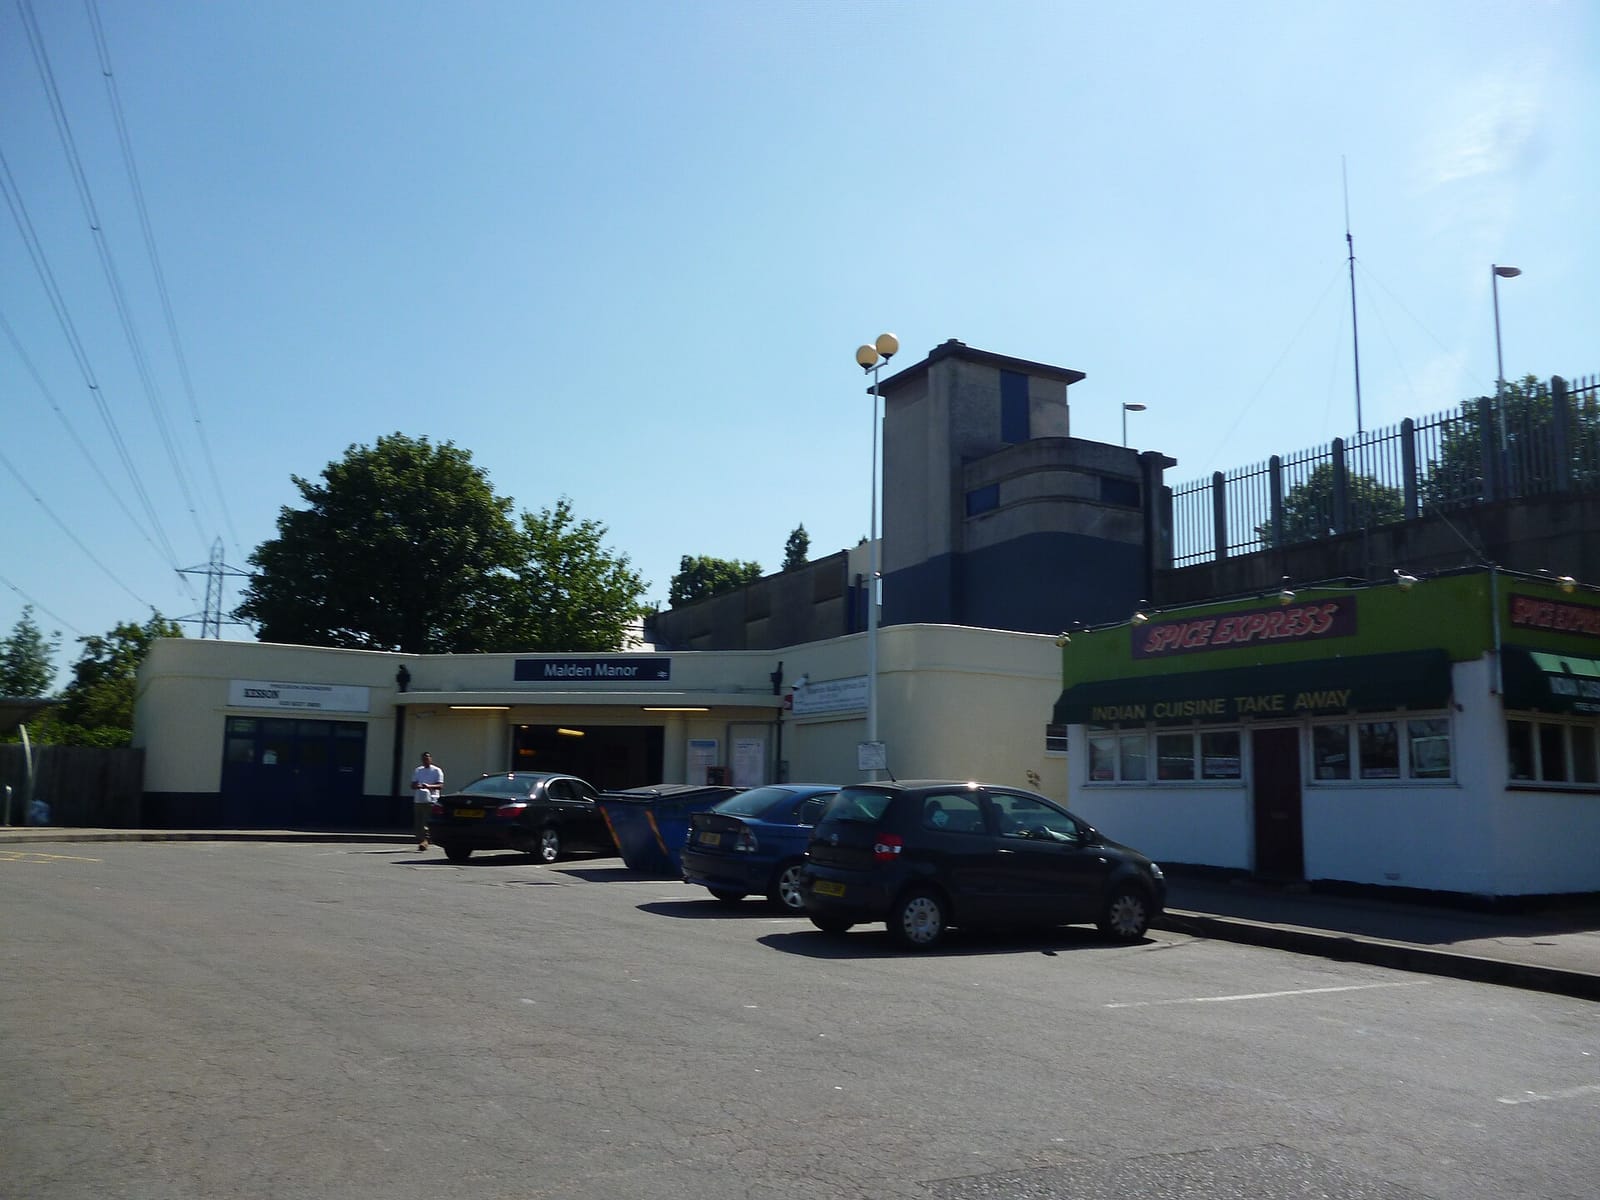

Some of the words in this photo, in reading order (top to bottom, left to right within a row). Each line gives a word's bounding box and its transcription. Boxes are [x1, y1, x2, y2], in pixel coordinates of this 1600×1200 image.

[1145, 619, 1216, 653] SPICE
[1211, 604, 1338, 645] EXPRESS
[544, 663, 592, 677] Malden
[595, 663, 639, 677] Manor
[1092, 704, 1146, 721] INDIAN
[1153, 698, 1225, 719] CUISINE
[1233, 694, 1286, 713] TAKE
[1294, 688, 1352, 710] AWAY
